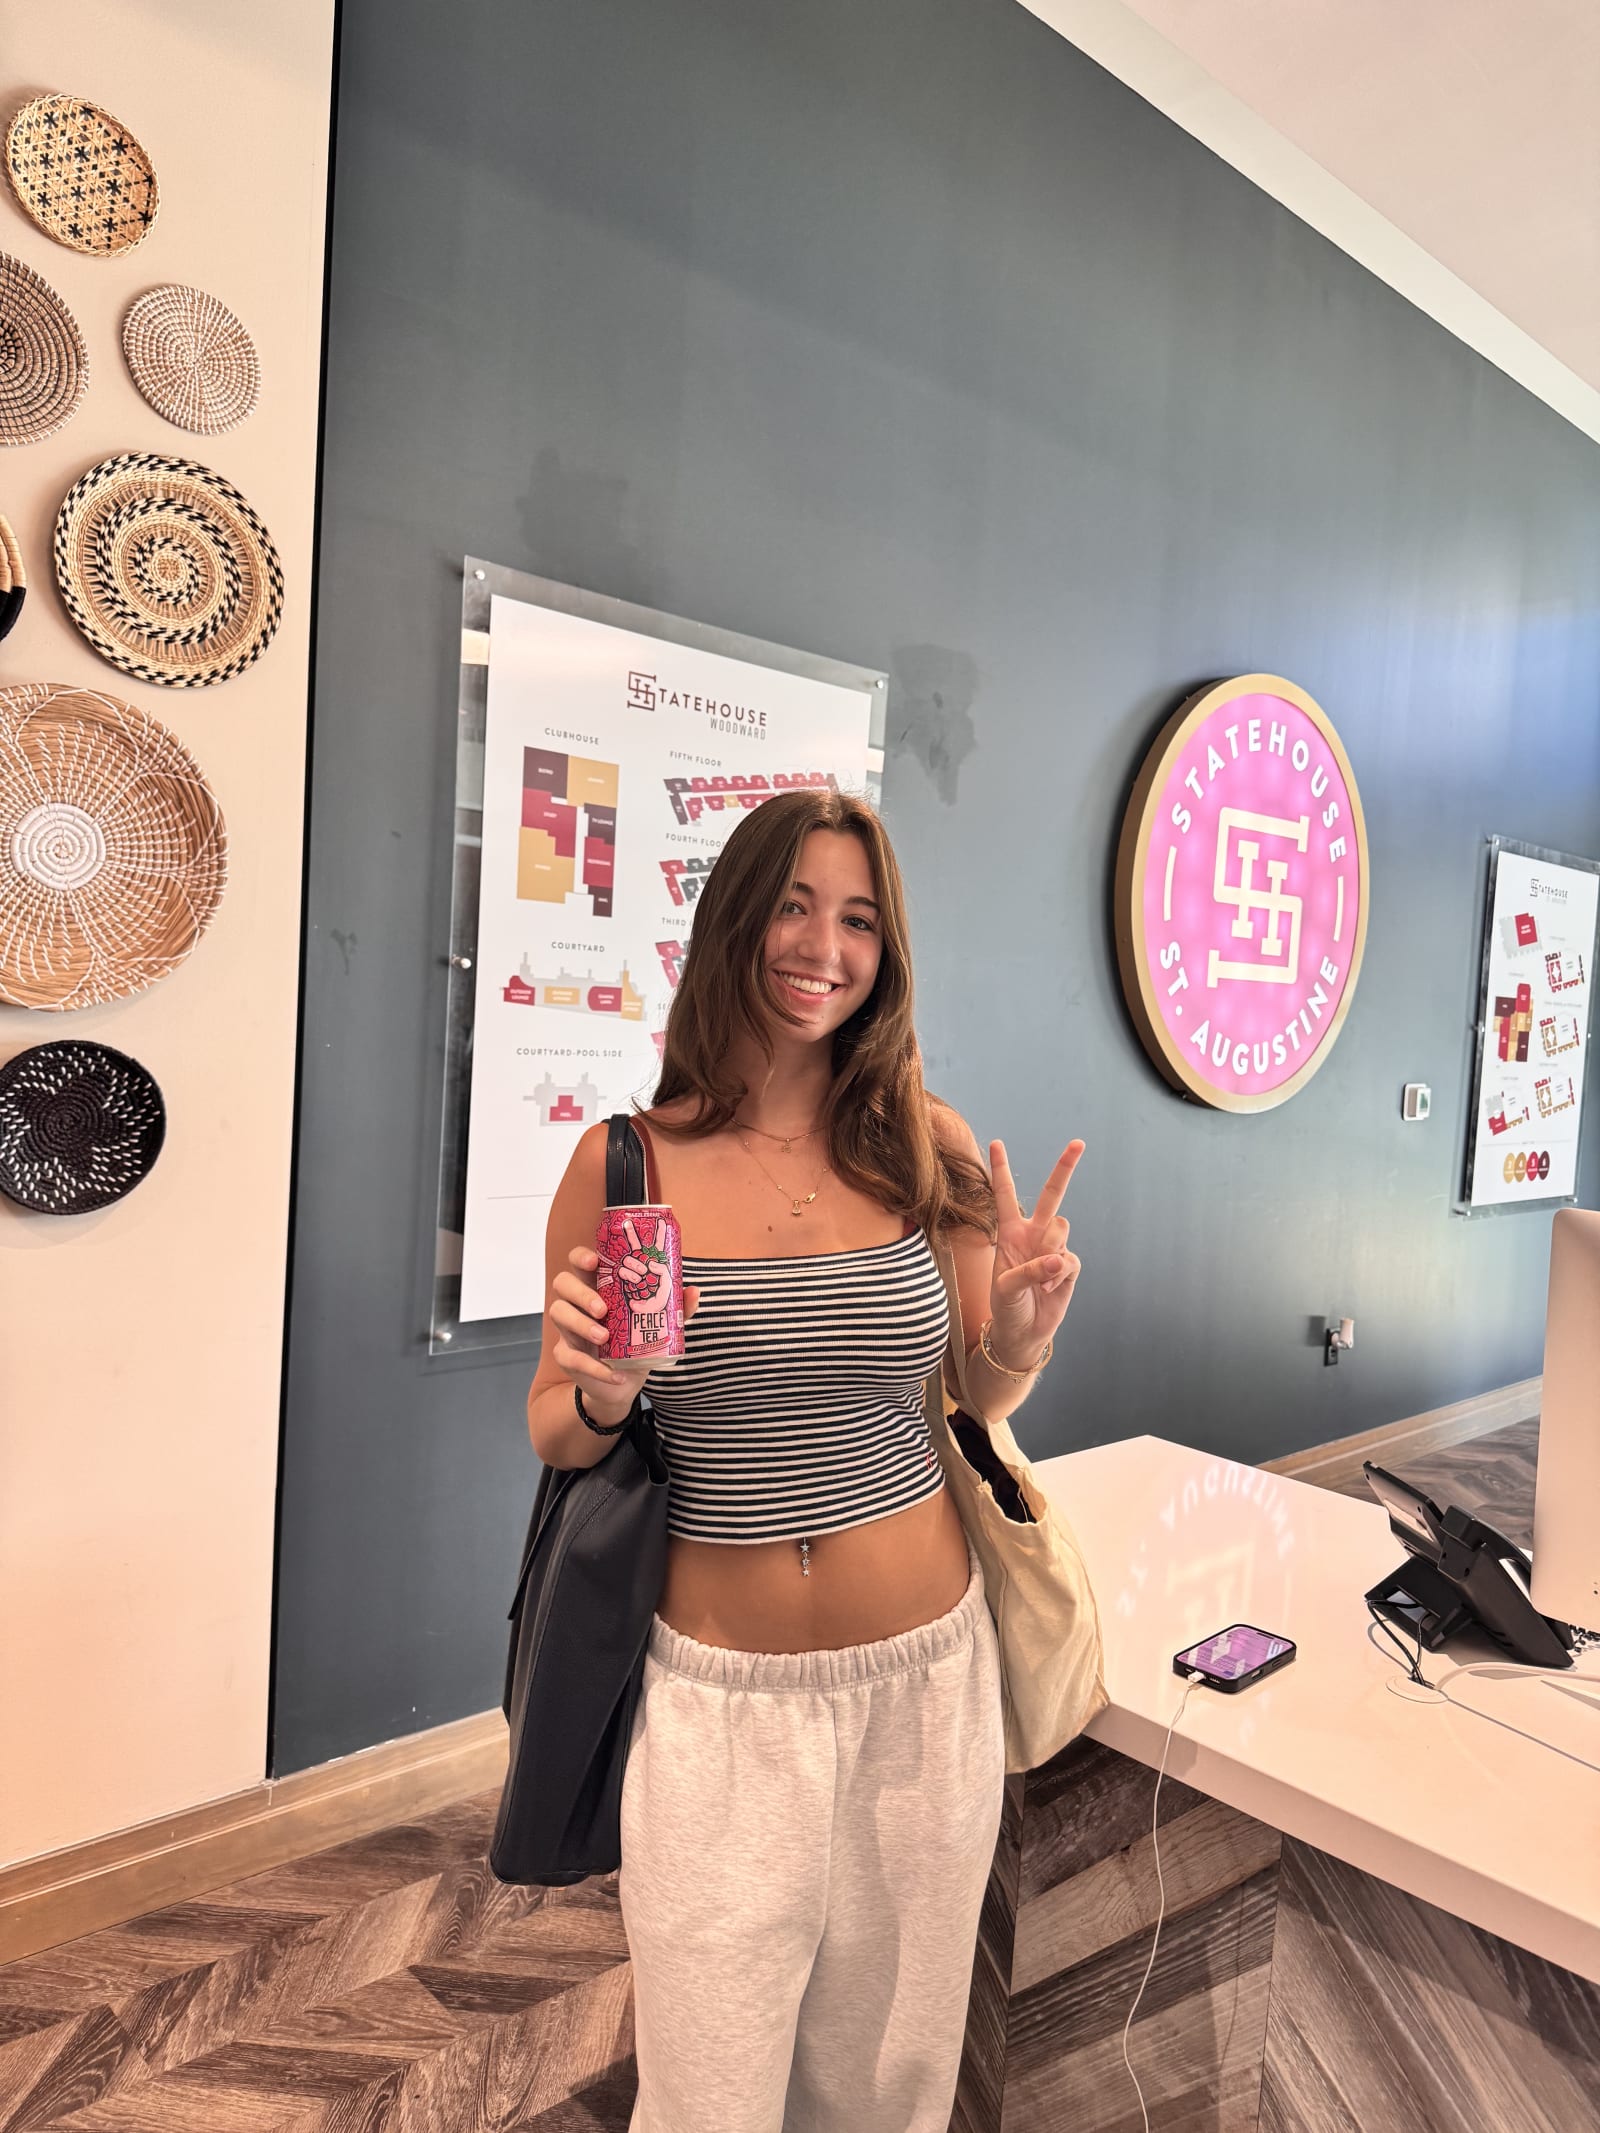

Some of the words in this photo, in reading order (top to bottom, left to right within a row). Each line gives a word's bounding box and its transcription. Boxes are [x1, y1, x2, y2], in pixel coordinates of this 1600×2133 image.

[544, 727, 600, 745] CLUBHOUSE
[709, 717, 767, 741] WOODWARD
[669, 750, 693, 763] FIFTH
[695, 754, 723, 767] FLOOR
[1171, 718, 1347, 863] STATEHOUSE
[665, 832, 698, 846] FOURTH
[661, 917, 687, 927] THIRD
[551, 941, 605, 953] COURTYARD
[1160, 941, 1190, 1017] ST.
[1190, 956, 1340, 1076] AUGUSTINE
[516, 1047, 600, 1058] COURTYARD-POOL
[603, 1049, 623, 1058] SIDE
[633, 1312, 665, 1330] PEACE
[639, 1329, 660, 1343] TEA
